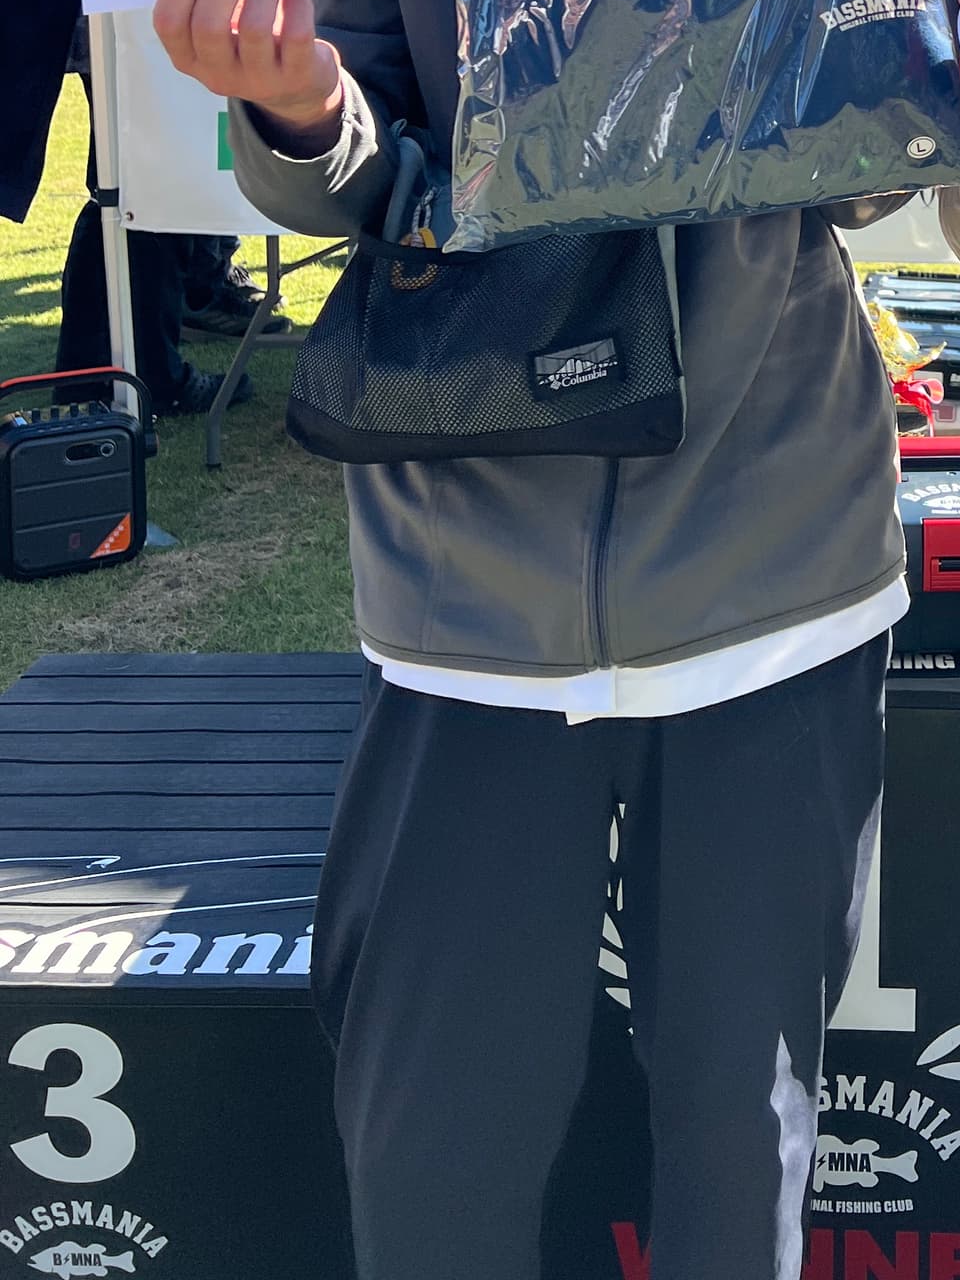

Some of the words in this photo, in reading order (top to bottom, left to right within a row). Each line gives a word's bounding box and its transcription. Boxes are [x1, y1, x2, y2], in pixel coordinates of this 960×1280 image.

[561, 369, 607, 387] Columbia
[8, 1023, 137, 1184] 3
[835, 1199, 882, 1214] FISHING
[883, 1199, 914, 1213] CLUB
[0, 1200, 169, 1259] BASSMANIA
